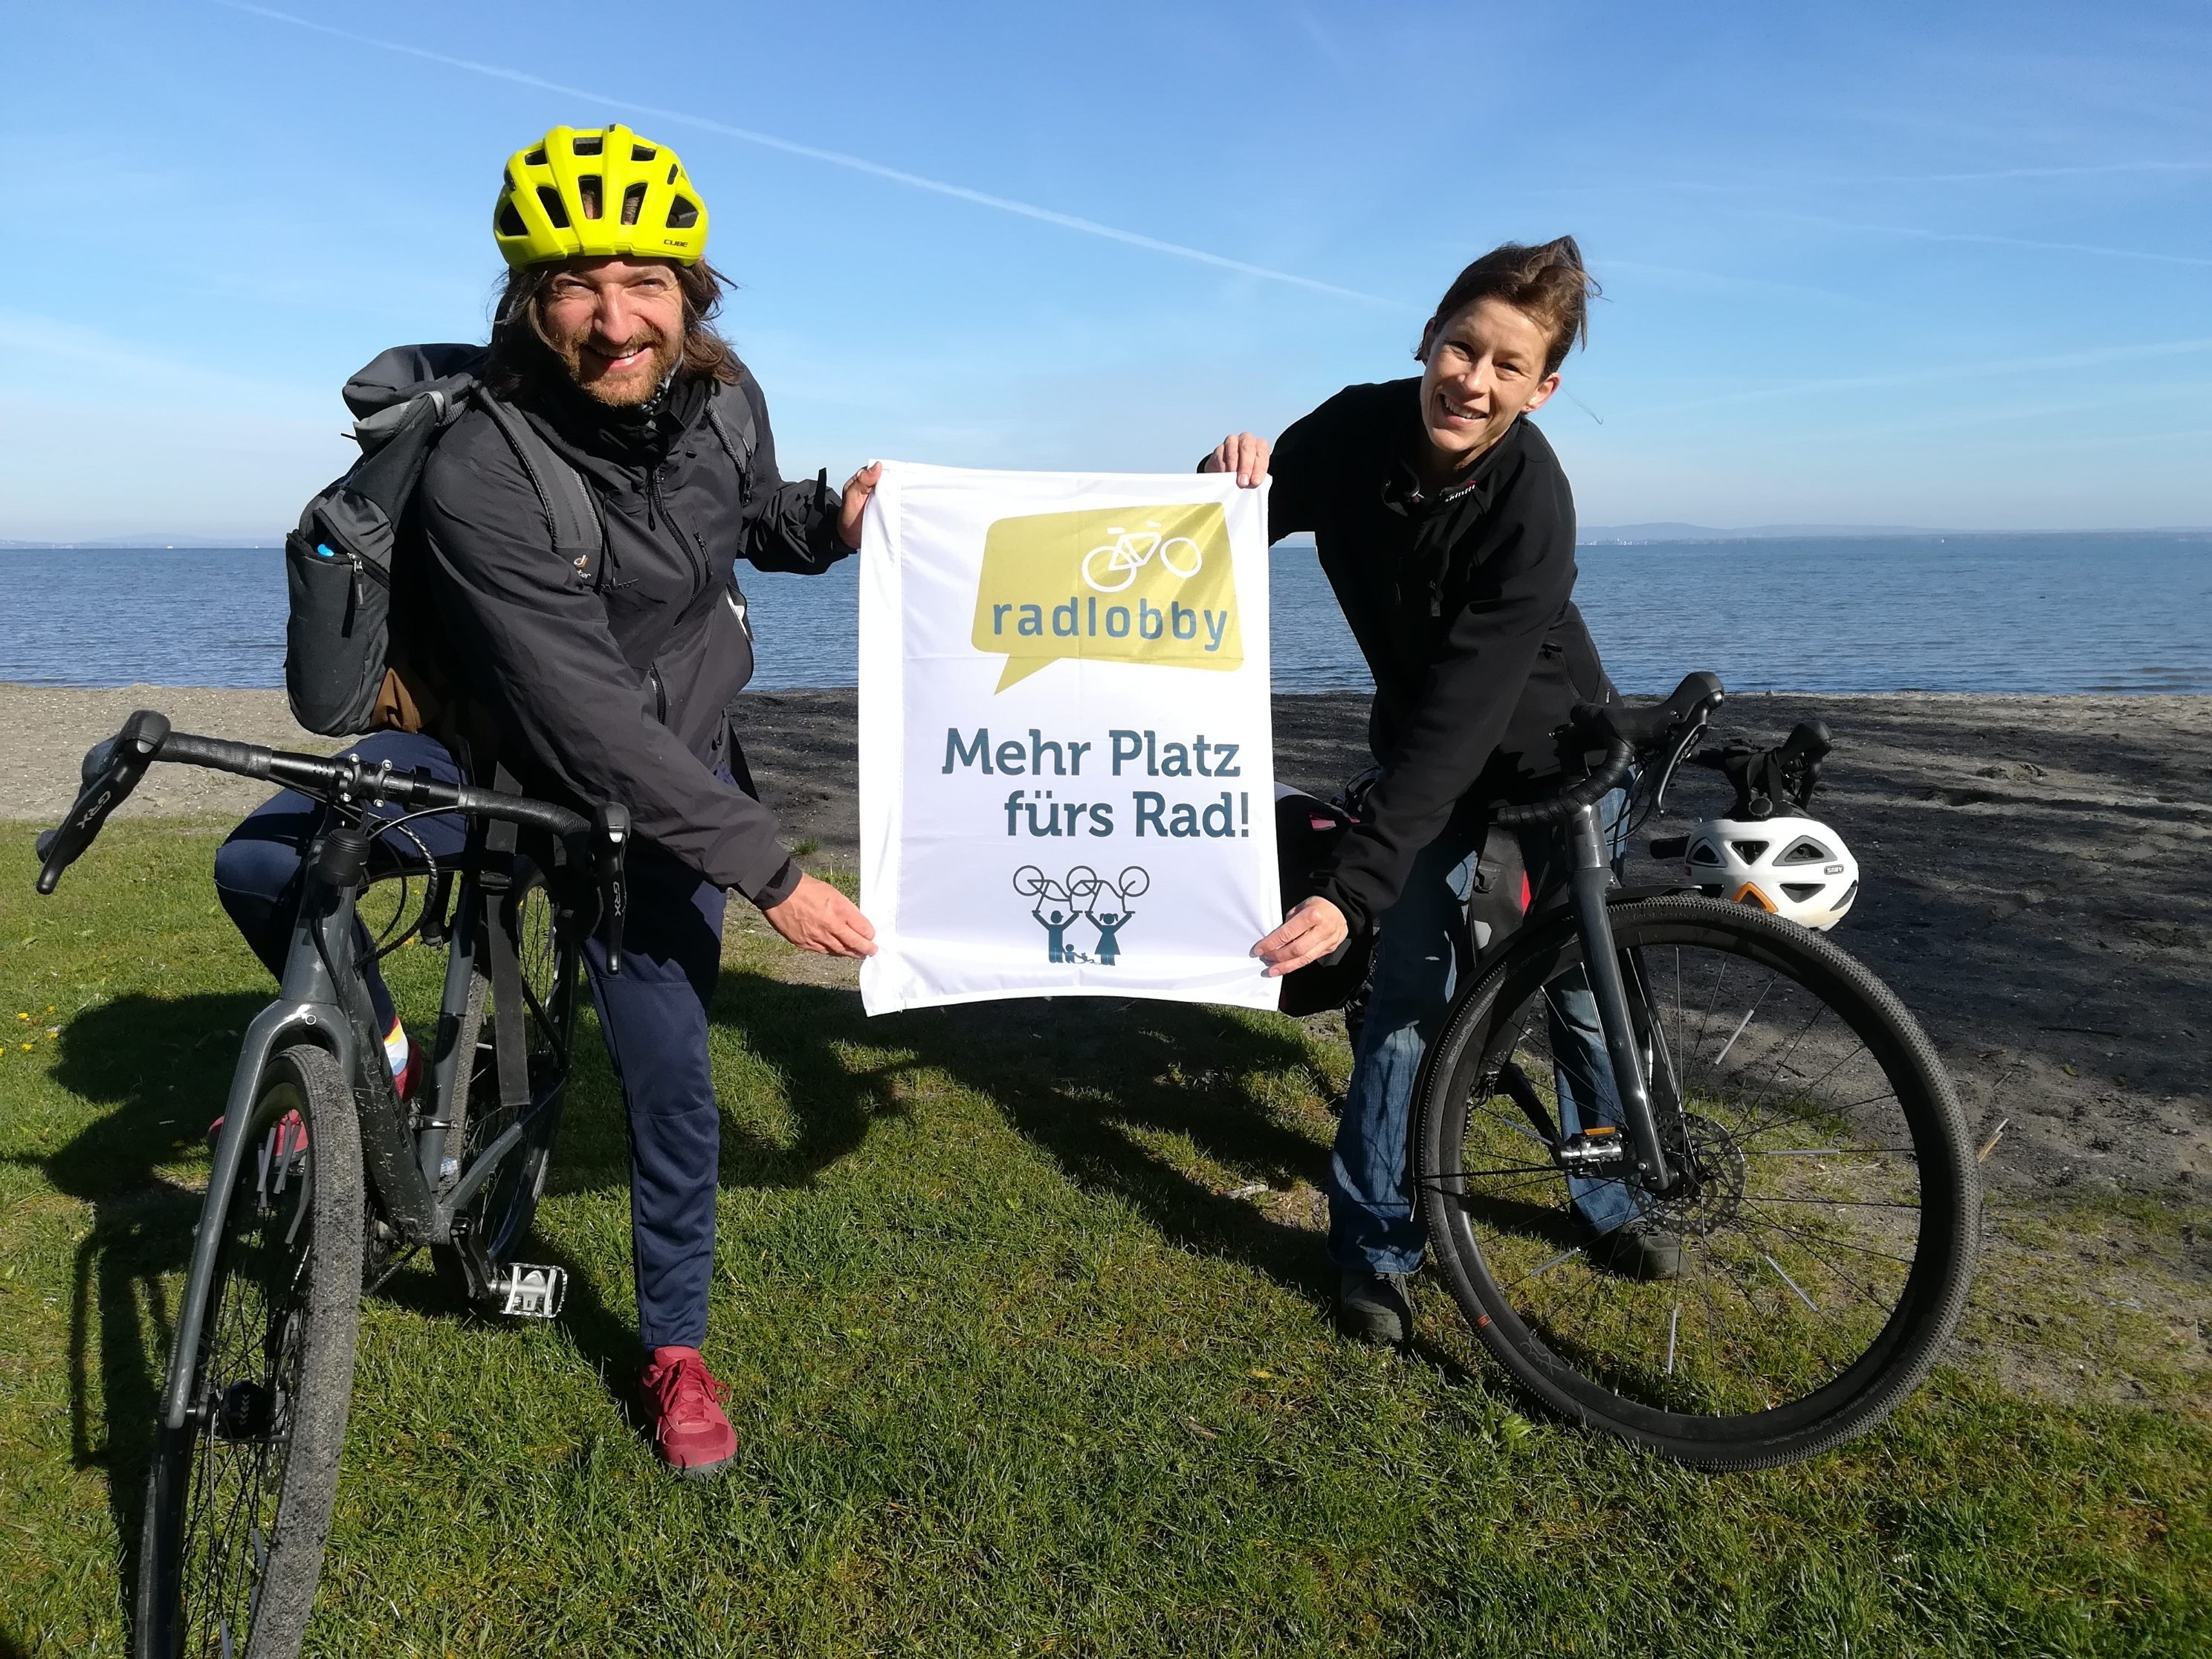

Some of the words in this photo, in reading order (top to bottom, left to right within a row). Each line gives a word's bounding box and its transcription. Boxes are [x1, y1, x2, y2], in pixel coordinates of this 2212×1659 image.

[663, 239, 688, 248] CUBE
[993, 596, 1228, 652] radlobby
[942, 728, 1091, 776] Mehr
[1109, 730, 1241, 777] Platz
[1676, 733, 1700, 766] GRX
[76, 790, 111, 830] GRX
[1004, 790, 1114, 838] fürs
[1132, 791, 1249, 838] Rad!
[612, 881, 621, 916] GRX
